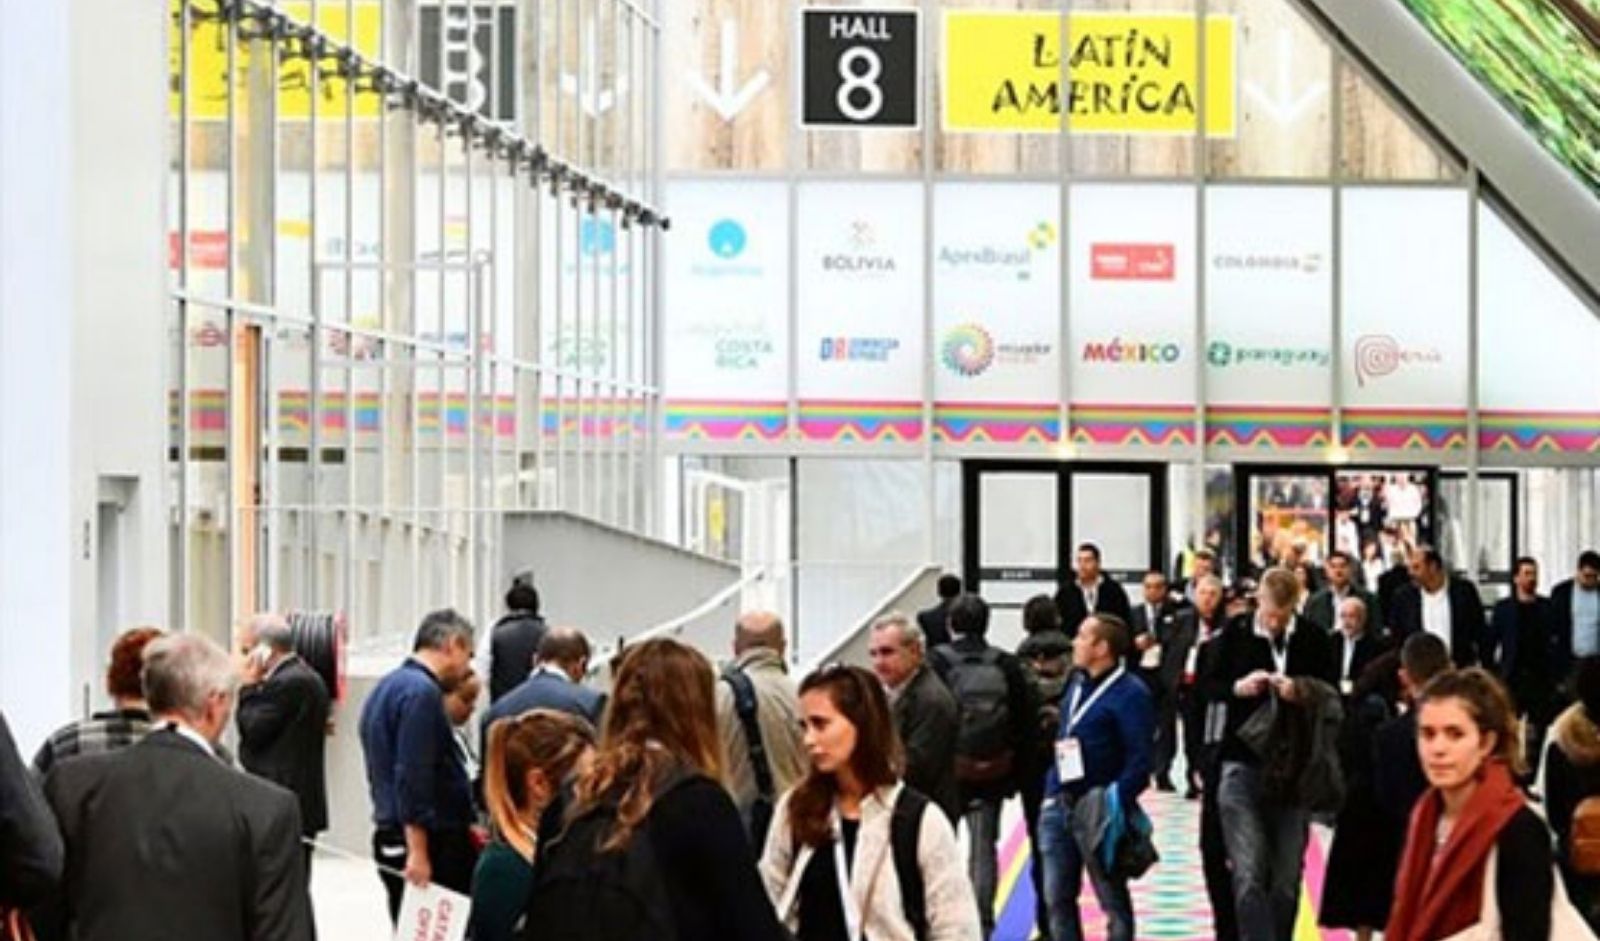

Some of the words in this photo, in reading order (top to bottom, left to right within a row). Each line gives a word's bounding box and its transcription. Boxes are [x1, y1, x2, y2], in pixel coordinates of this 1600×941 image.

[829, 17, 892, 39] HALL
[1032, 29, 1171, 69] LATIN
[836, 46, 883, 121] 8
[991, 75, 1196, 115] AMERICA
[822, 254, 896, 272] BOLIVIA
[1213, 256, 1299, 270] COLOMBIA
[714, 339, 774, 353] COSTA
[714, 354, 758, 369] RICA
